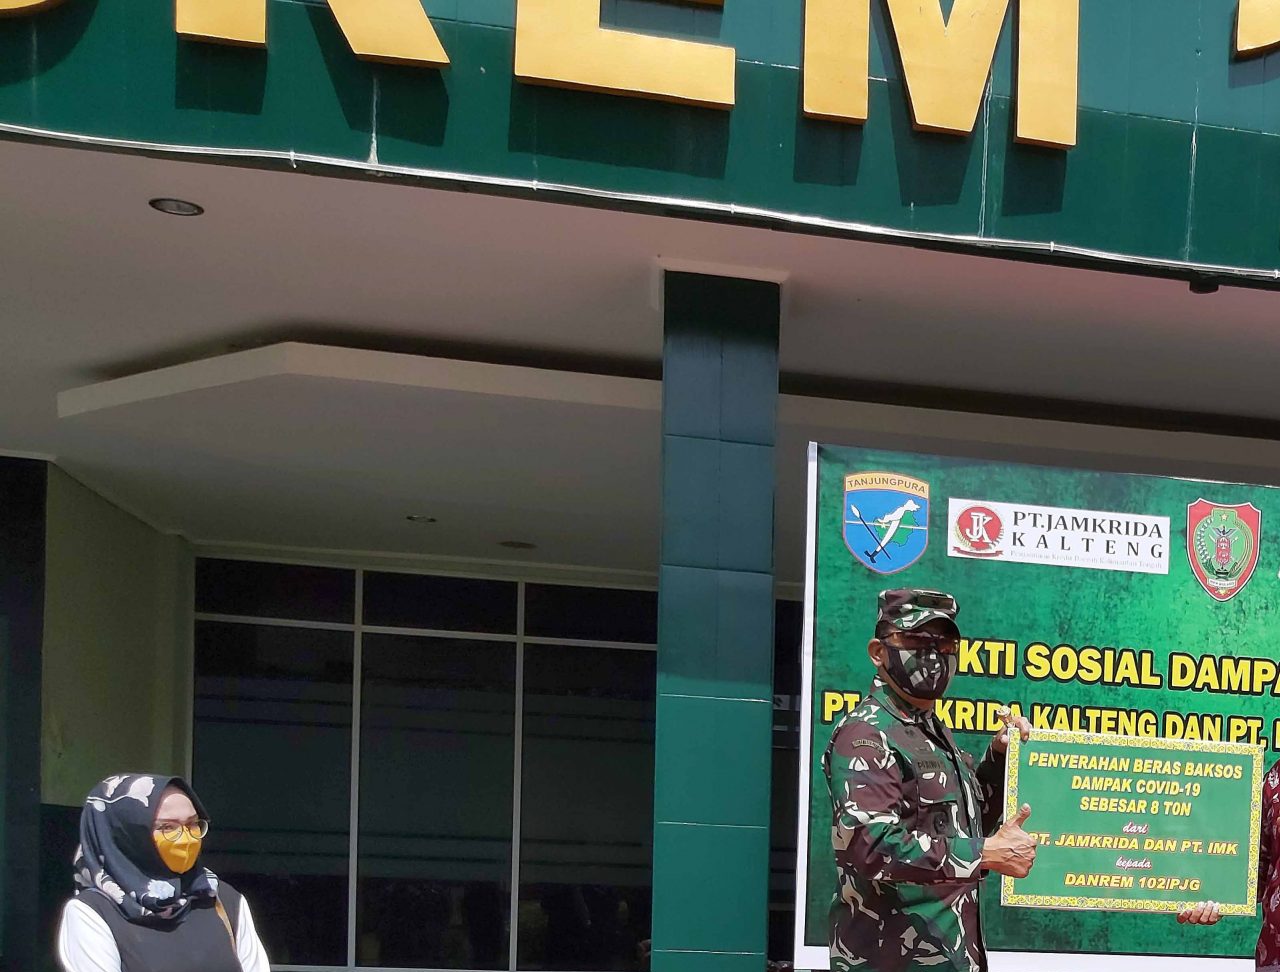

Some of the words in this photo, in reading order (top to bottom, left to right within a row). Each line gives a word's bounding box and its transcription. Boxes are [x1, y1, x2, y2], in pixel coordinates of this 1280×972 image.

[847, 476, 926, 494] TANJUNGPURA
[1011, 531, 1163, 559] KALTENG
[958, 638, 1016, 677] KTI
[1025, 644, 1161, 686] SOSIAL
[935, 699, 1022, 733] KRIDA
[1033, 705, 1156, 738] KALTENG
[1165, 715, 1224, 743] DAN
[1028, 751, 1130, 772] PENYERAHAN
[1132, 757, 1181, 776] BERAS
[1184, 762, 1243, 780] BAKSOS
[1071, 775, 1132, 793] DAMPAK
[1135, 780, 1201, 797] COVID-19
[1080, 796, 1147, 814] SEBESAR
[1150, 801, 1160, 815] 8
[1163, 801, 1192, 817] TON
[1122, 821, 1148, 835] dari
[1055, 834, 1139, 850] JAMKRIDA
[1143, 838, 1177, 852] DAN
[1180, 841, 1203, 854] PT.
[1208, 842, 1239, 855] IMK
[1115, 856, 1152, 870] kepada
[1064, 873, 1134, 889] DANREM
[1139, 876, 1201, 891] 102/PJG
